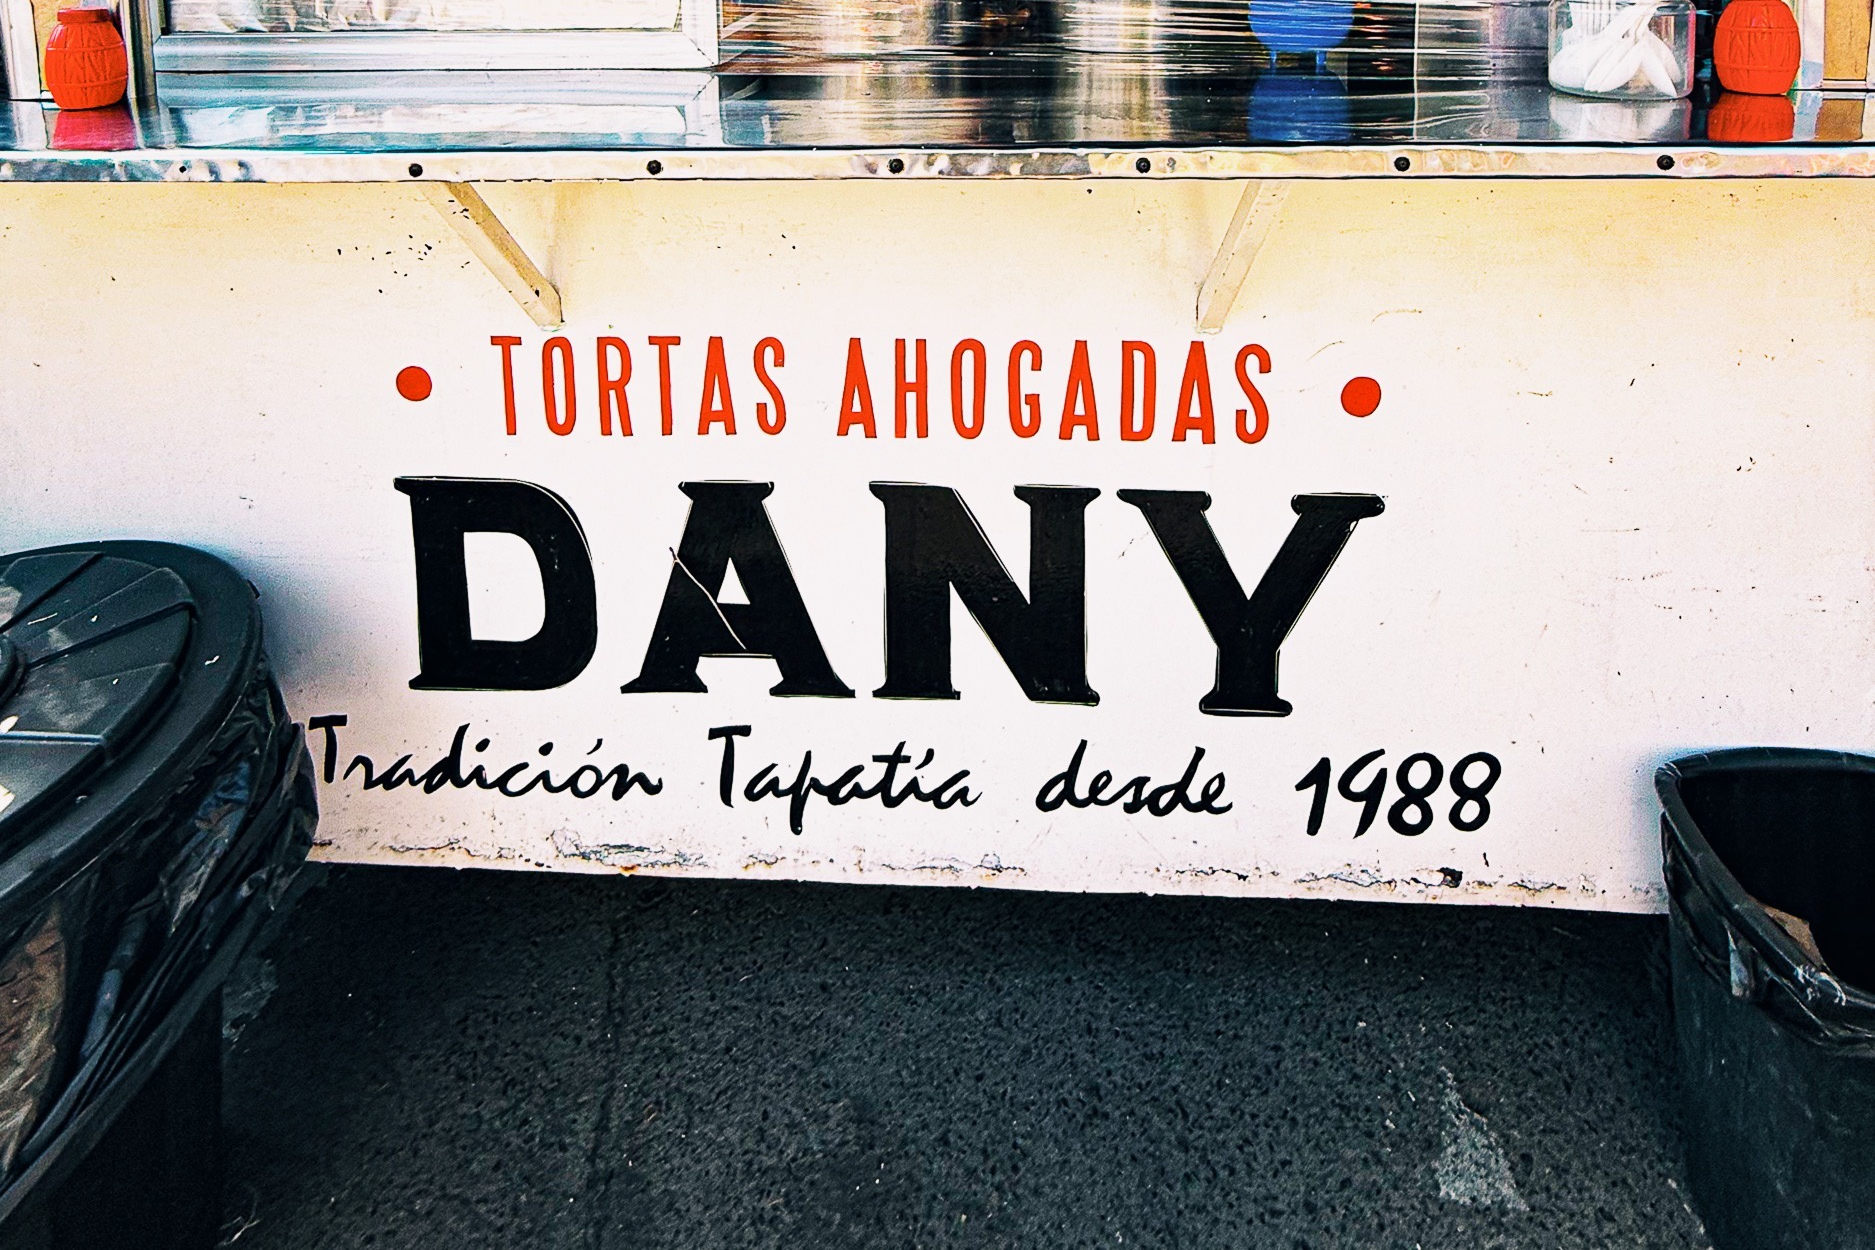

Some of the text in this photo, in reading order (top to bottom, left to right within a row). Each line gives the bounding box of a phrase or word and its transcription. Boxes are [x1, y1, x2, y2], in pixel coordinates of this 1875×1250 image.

[490, 335, 1272, 445] TORTAS AHOGADAS
[393, 476, 1386, 717] DANY
[308, 714, 1502, 838] Tradición Tapatía desde 1988
